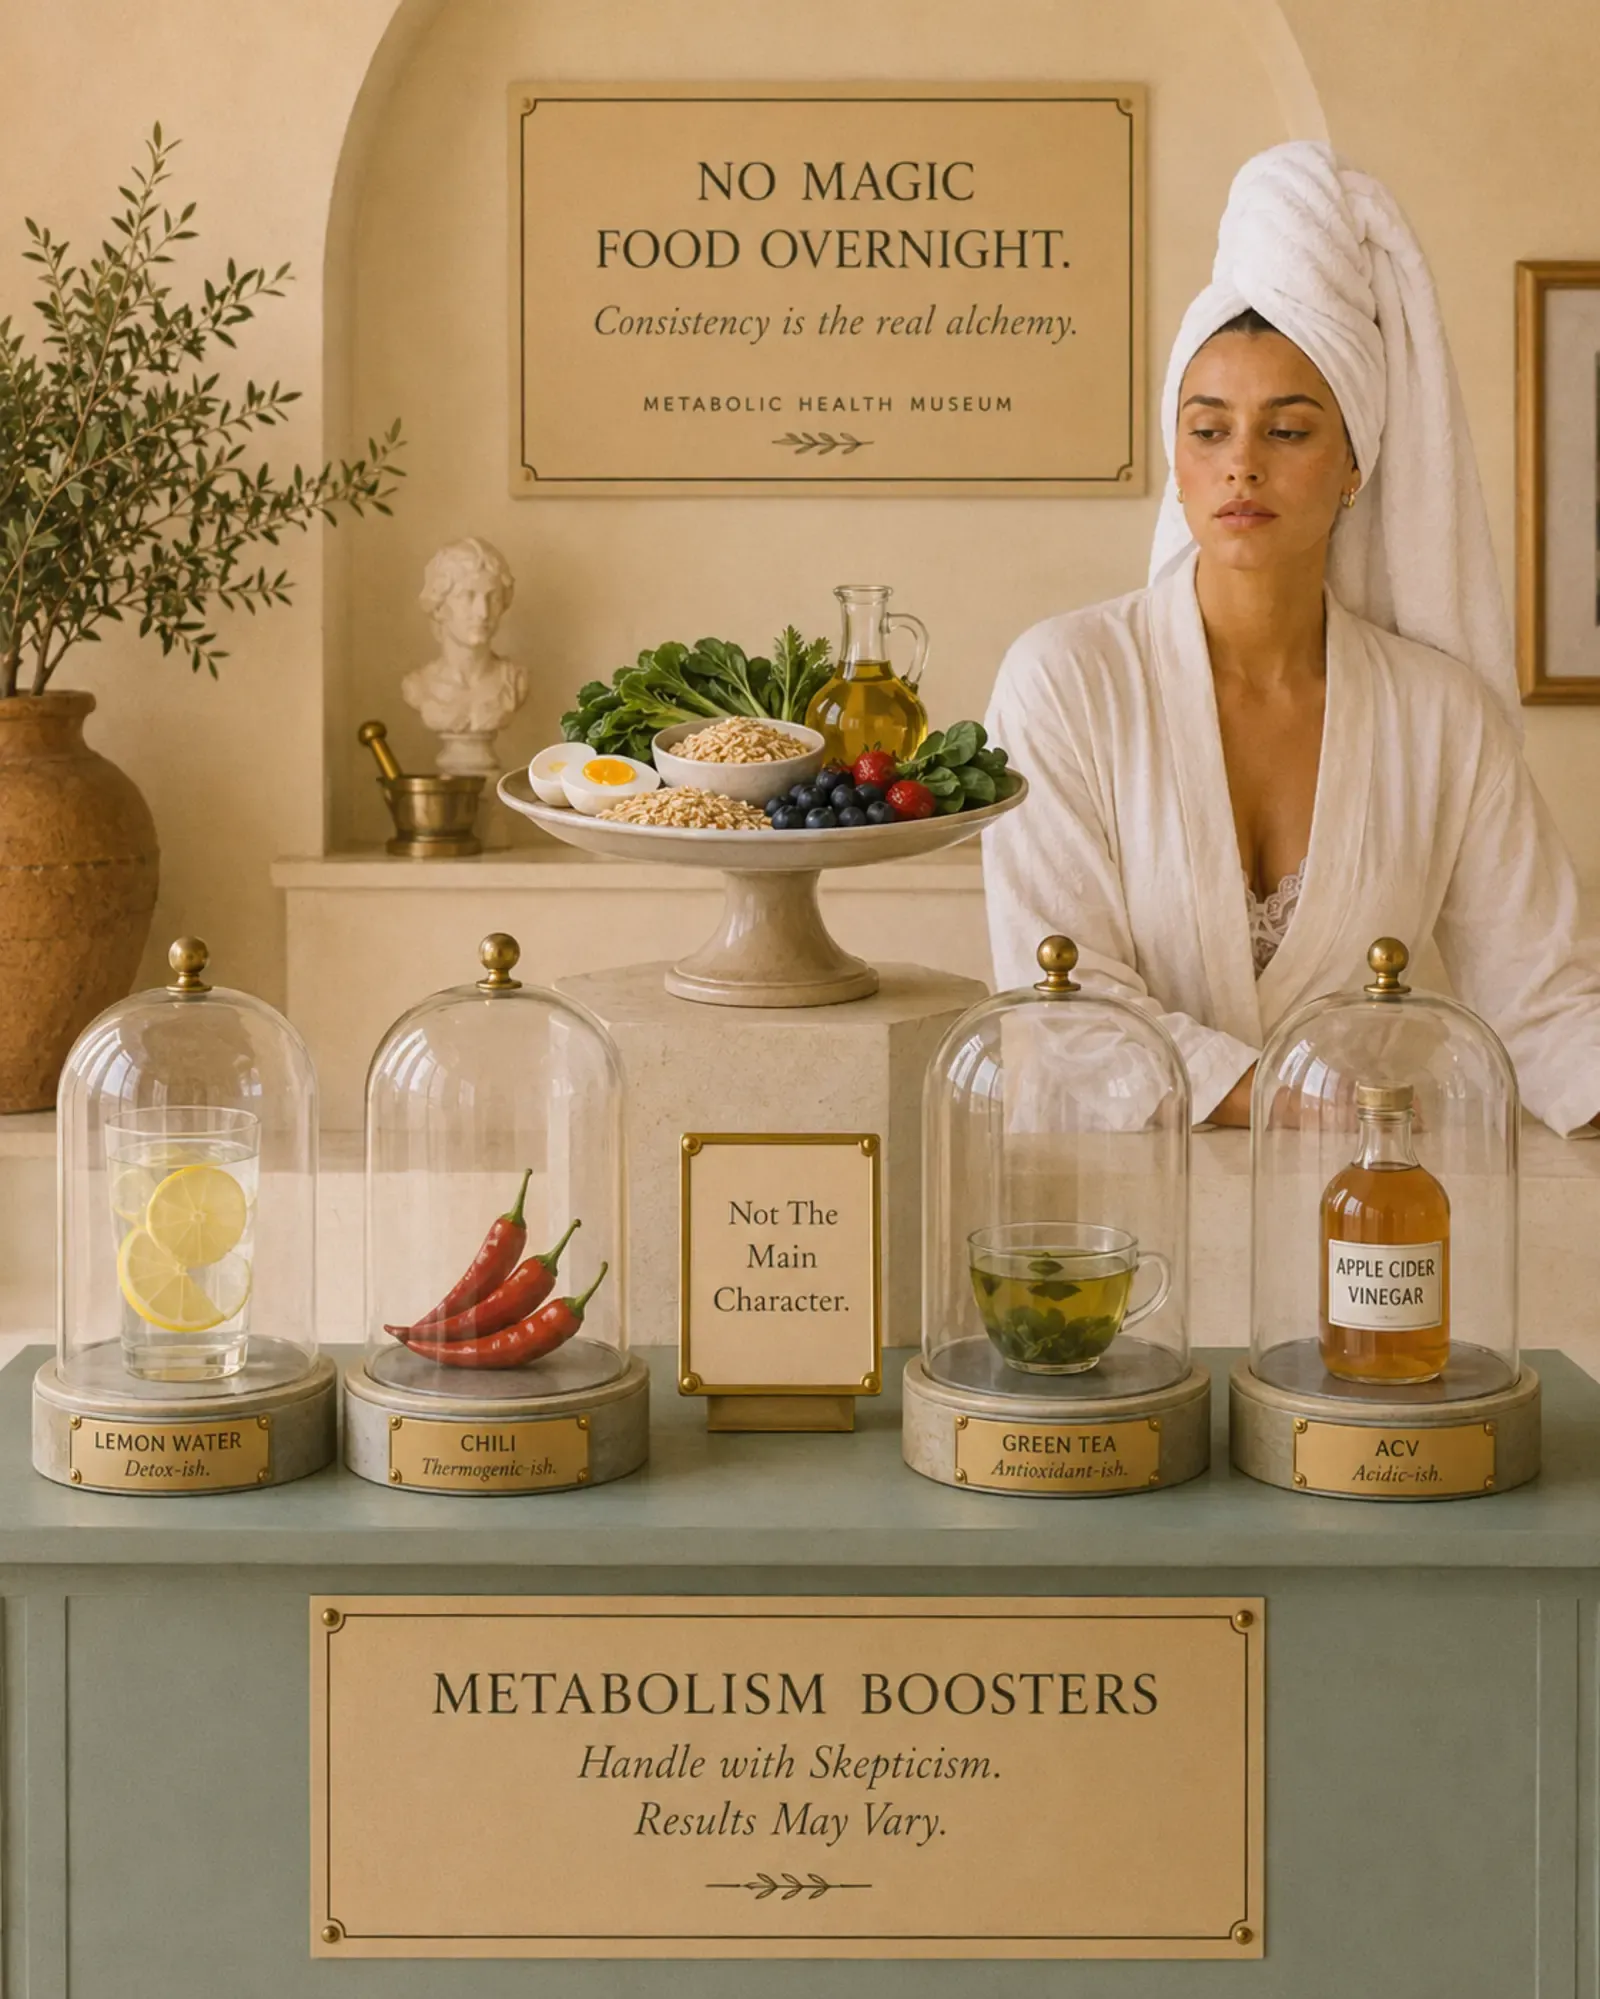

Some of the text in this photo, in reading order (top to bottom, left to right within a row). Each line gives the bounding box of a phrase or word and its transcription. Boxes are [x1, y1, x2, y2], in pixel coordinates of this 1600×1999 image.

[699, 162, 973, 201] NO MAGIC
[598, 230, 1069, 268] FOOD OVERNIGHT.
[595, 304, 1076, 344] Consistency is the real alchemy.
[644, 396, 1011, 412] METABOLIC HEALTH MUSEUM
[730, 1200, 837, 1225] Not The
[748, 1244, 816, 1268] Main
[1337, 1258, 1435, 1278] APPLE CIDER
[714, 1287, 849, 1312] Character.
[1349, 1286, 1423, 1306] VINEGAR
[95, 1431, 241, 1452] LEMON WATER
[461, 1435, 515, 1452] CHILI
[1003, 1435, 1116, 1454] GREEN TEA
[1376, 1440, 1419, 1457] ACV
[125, 1459, 210, 1477] Detox-ish.
[422, 1457, 557, 1482] Thermogenic-ish.
[991, 1459, 1128, 1479] Antioxidant-ish.
[1352, 1464, 1443, 1482] Acidic-ish.
[434, 1673, 1157, 1715] METABOLISM BOOSTERS
[578, 1744, 999, 1790] Handle with Skepticism.
[635, 1800, 945, 1847] Results May Vary.
